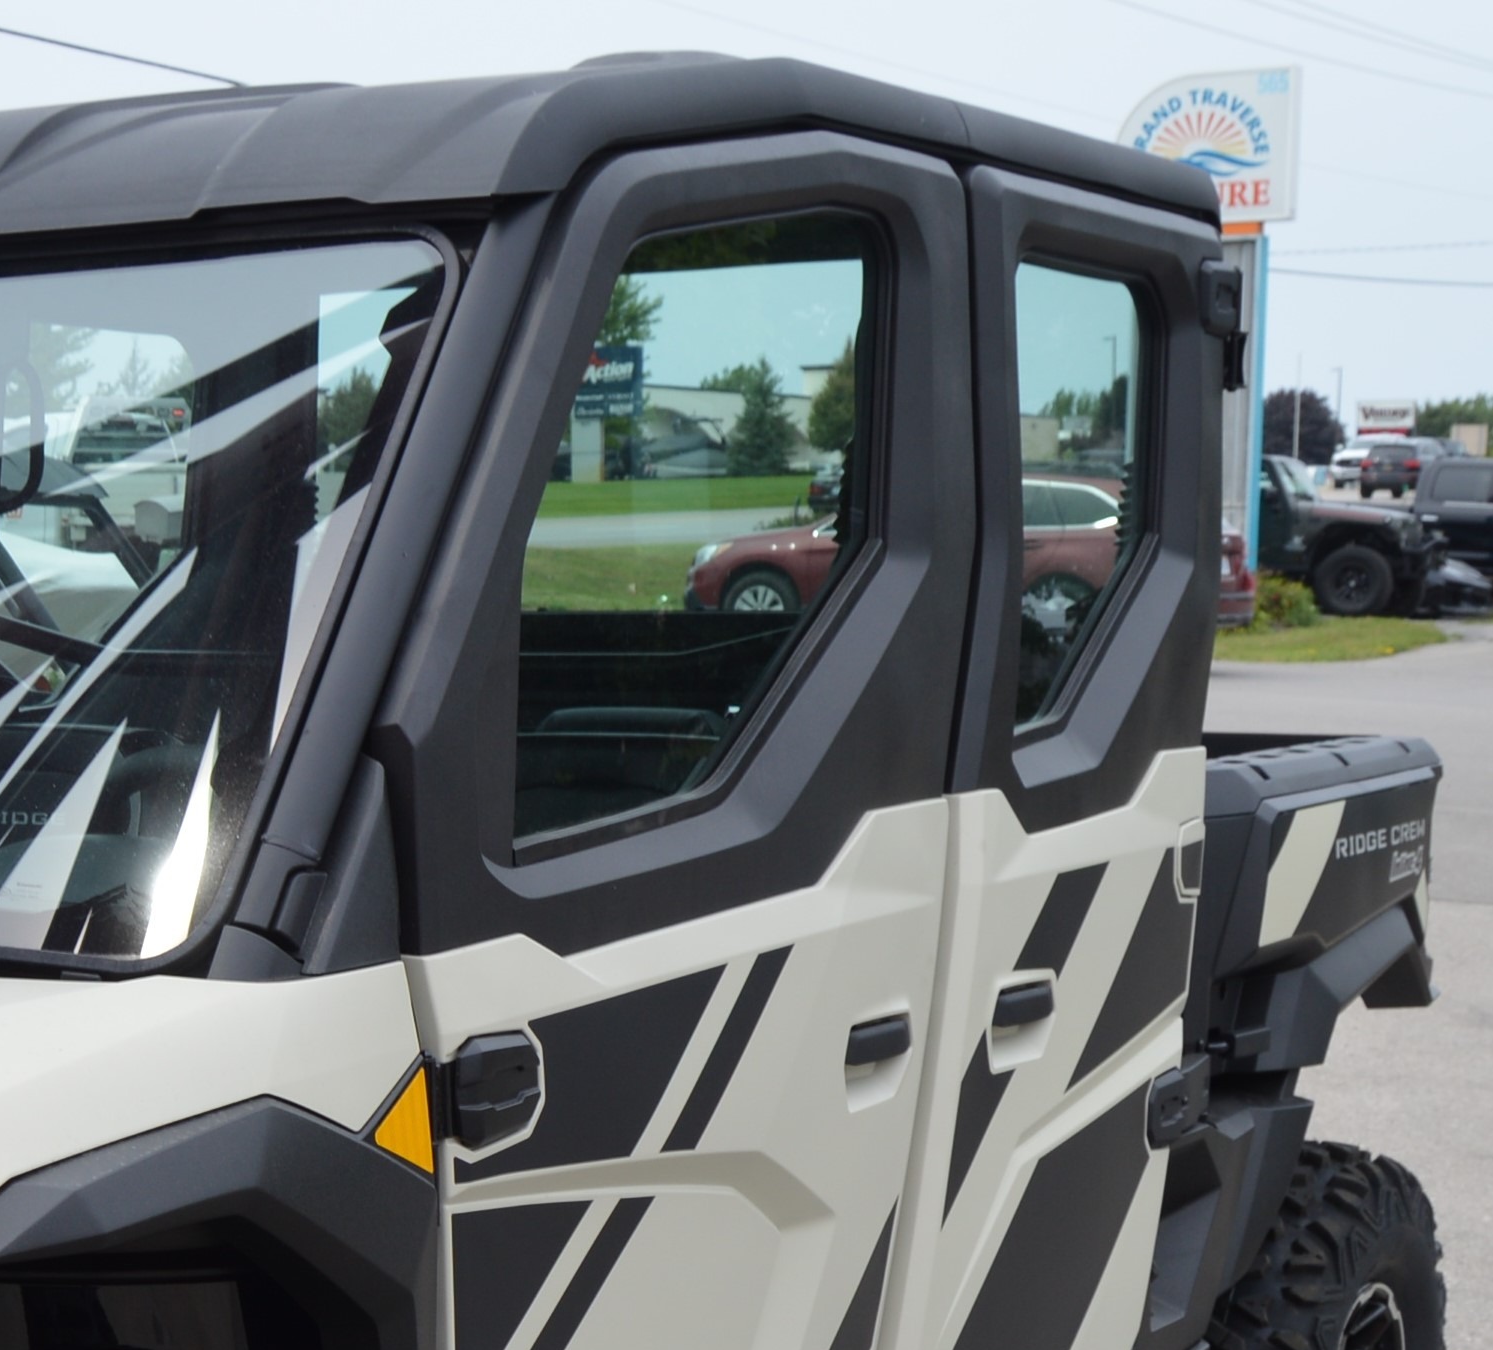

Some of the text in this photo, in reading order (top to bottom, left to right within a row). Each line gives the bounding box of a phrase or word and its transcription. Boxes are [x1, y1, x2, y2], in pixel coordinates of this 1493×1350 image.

[1134, 88, 1269, 154] RAND TRAVERSE
[1336, 818, 1426, 859] RIDGE CREW
